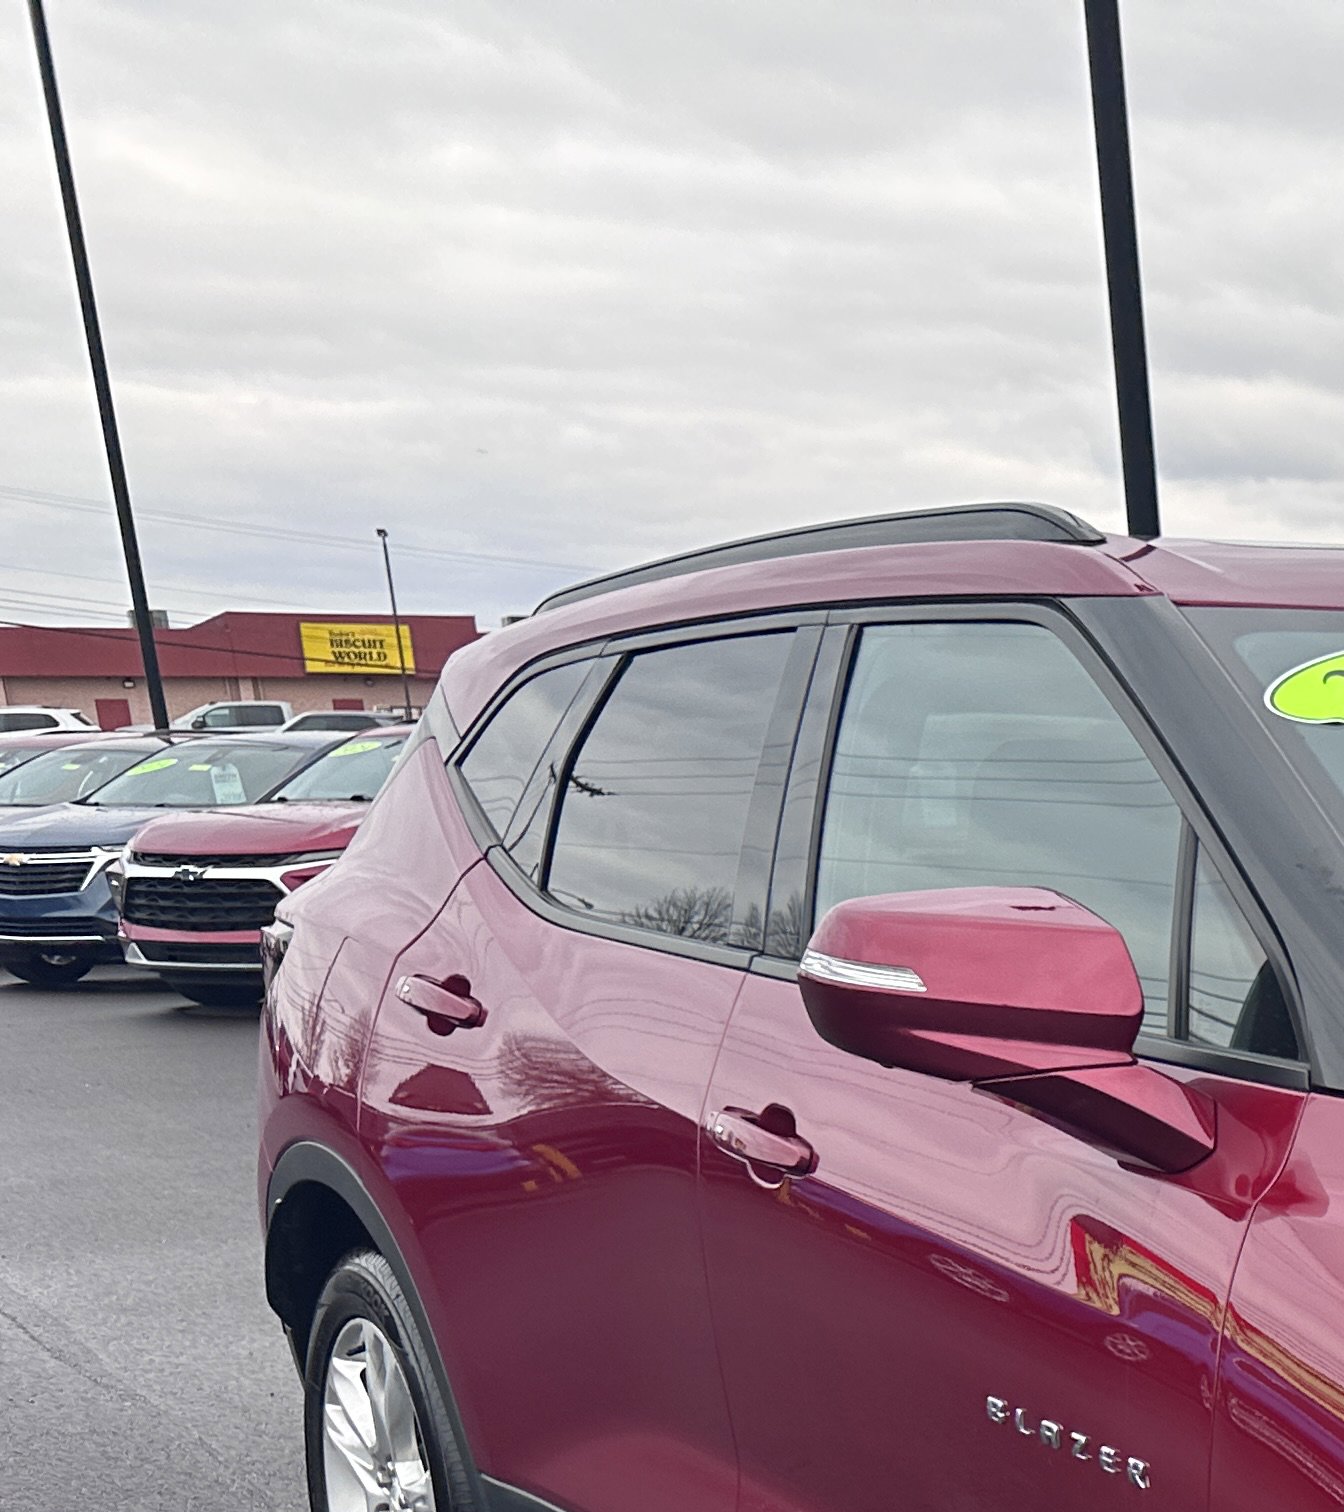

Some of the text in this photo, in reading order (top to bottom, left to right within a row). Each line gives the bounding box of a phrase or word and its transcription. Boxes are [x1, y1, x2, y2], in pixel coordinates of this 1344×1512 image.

[330, 638, 386, 649] BISCUIT
[331, 650, 388, 662] WORLD
[986, 1395, 1150, 1489] BLAZER
